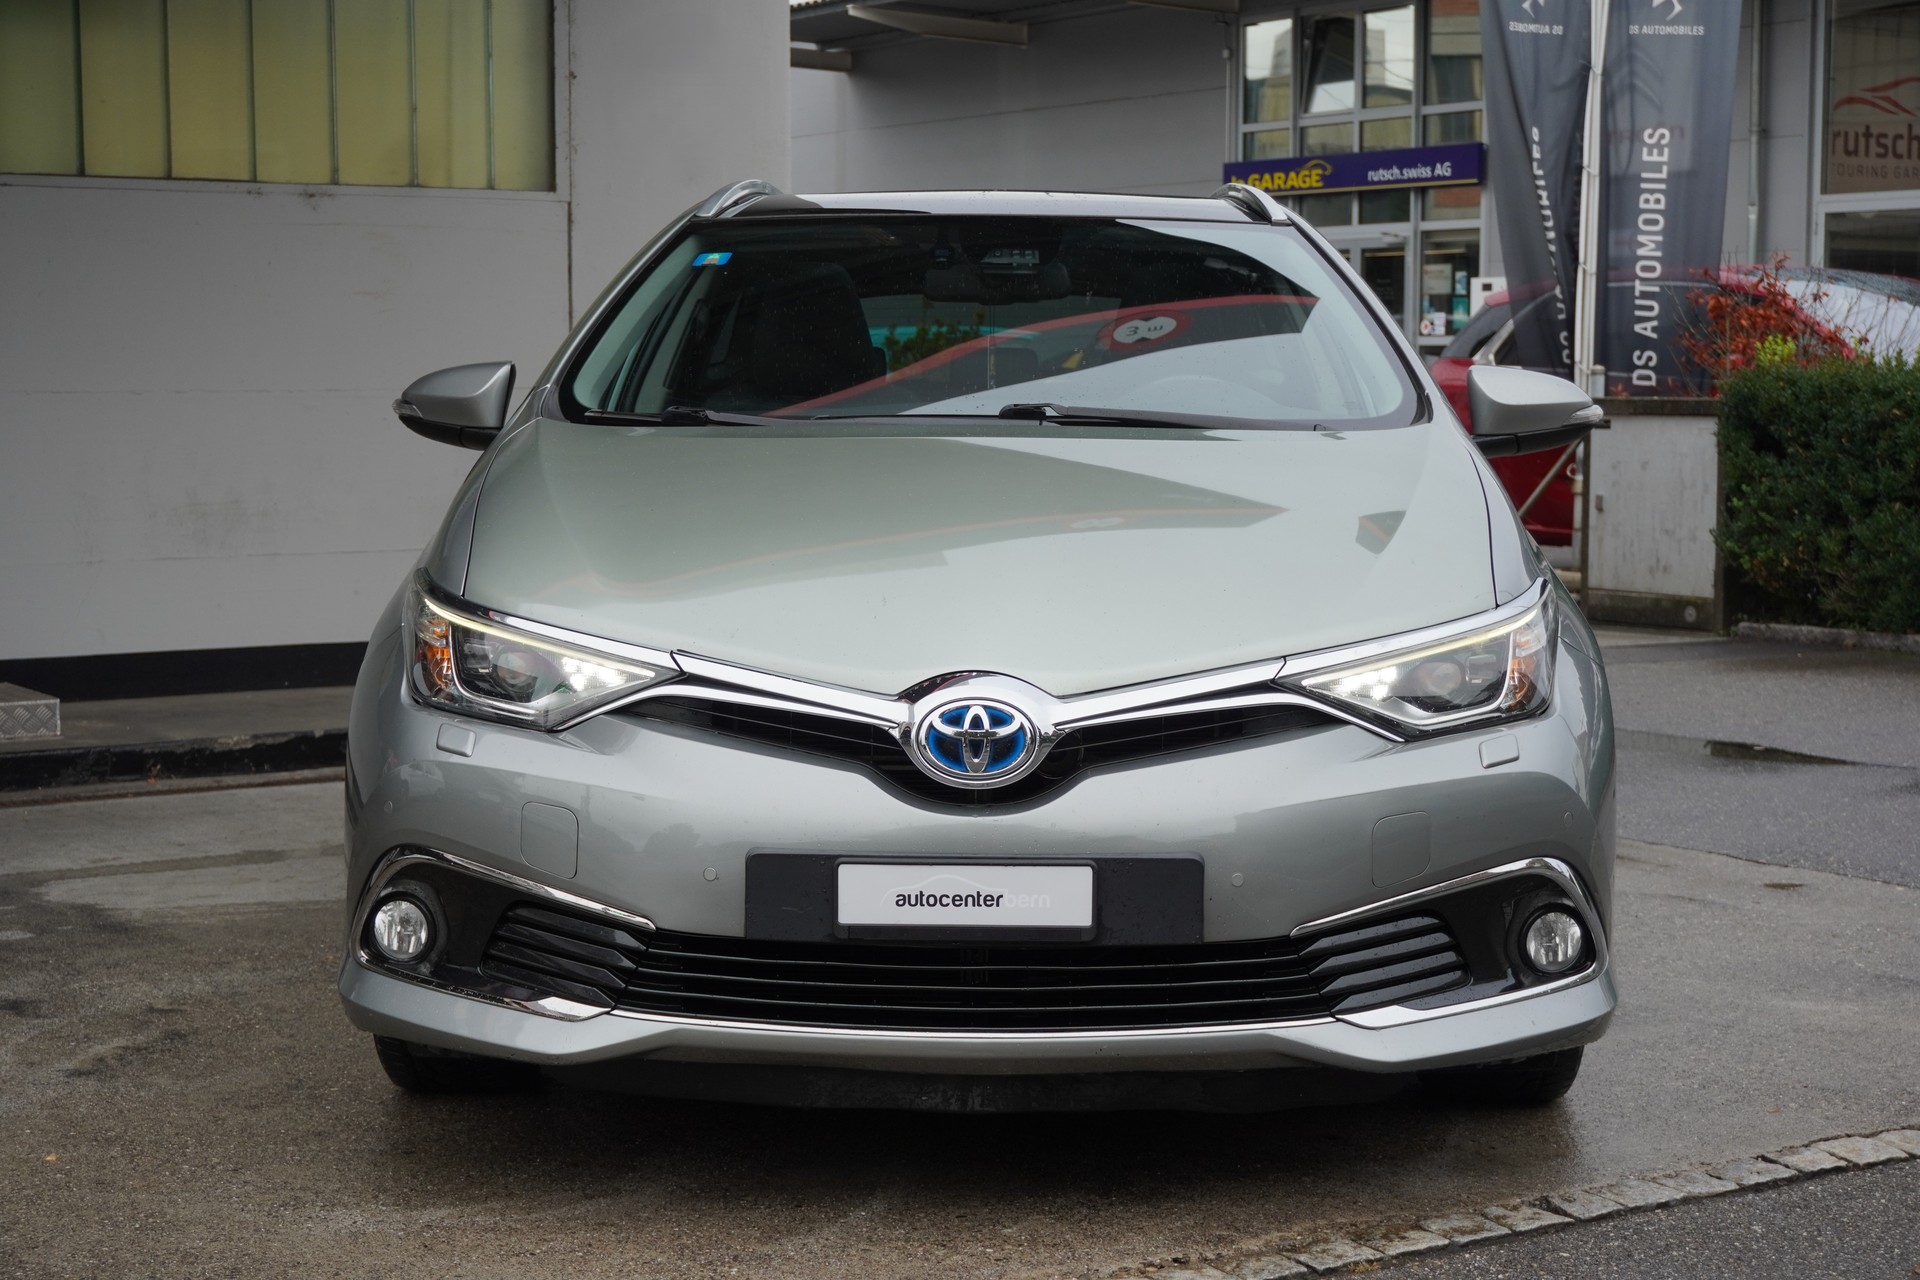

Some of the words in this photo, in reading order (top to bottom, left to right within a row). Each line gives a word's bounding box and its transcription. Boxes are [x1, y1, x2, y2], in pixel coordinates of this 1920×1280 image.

[1641, 24, 1704, 36] AUTOMOBILES
[1832, 123, 1920, 160] rutsch
[1248, 169, 1323, 190] GARAGE
[1369, 163, 1431, 181] rutsch.swiss
[1434, 161, 1452, 176] AG
[1633, 127, 1670, 339] AUTOMOBILES
[1632, 350, 1657, 387] DS
